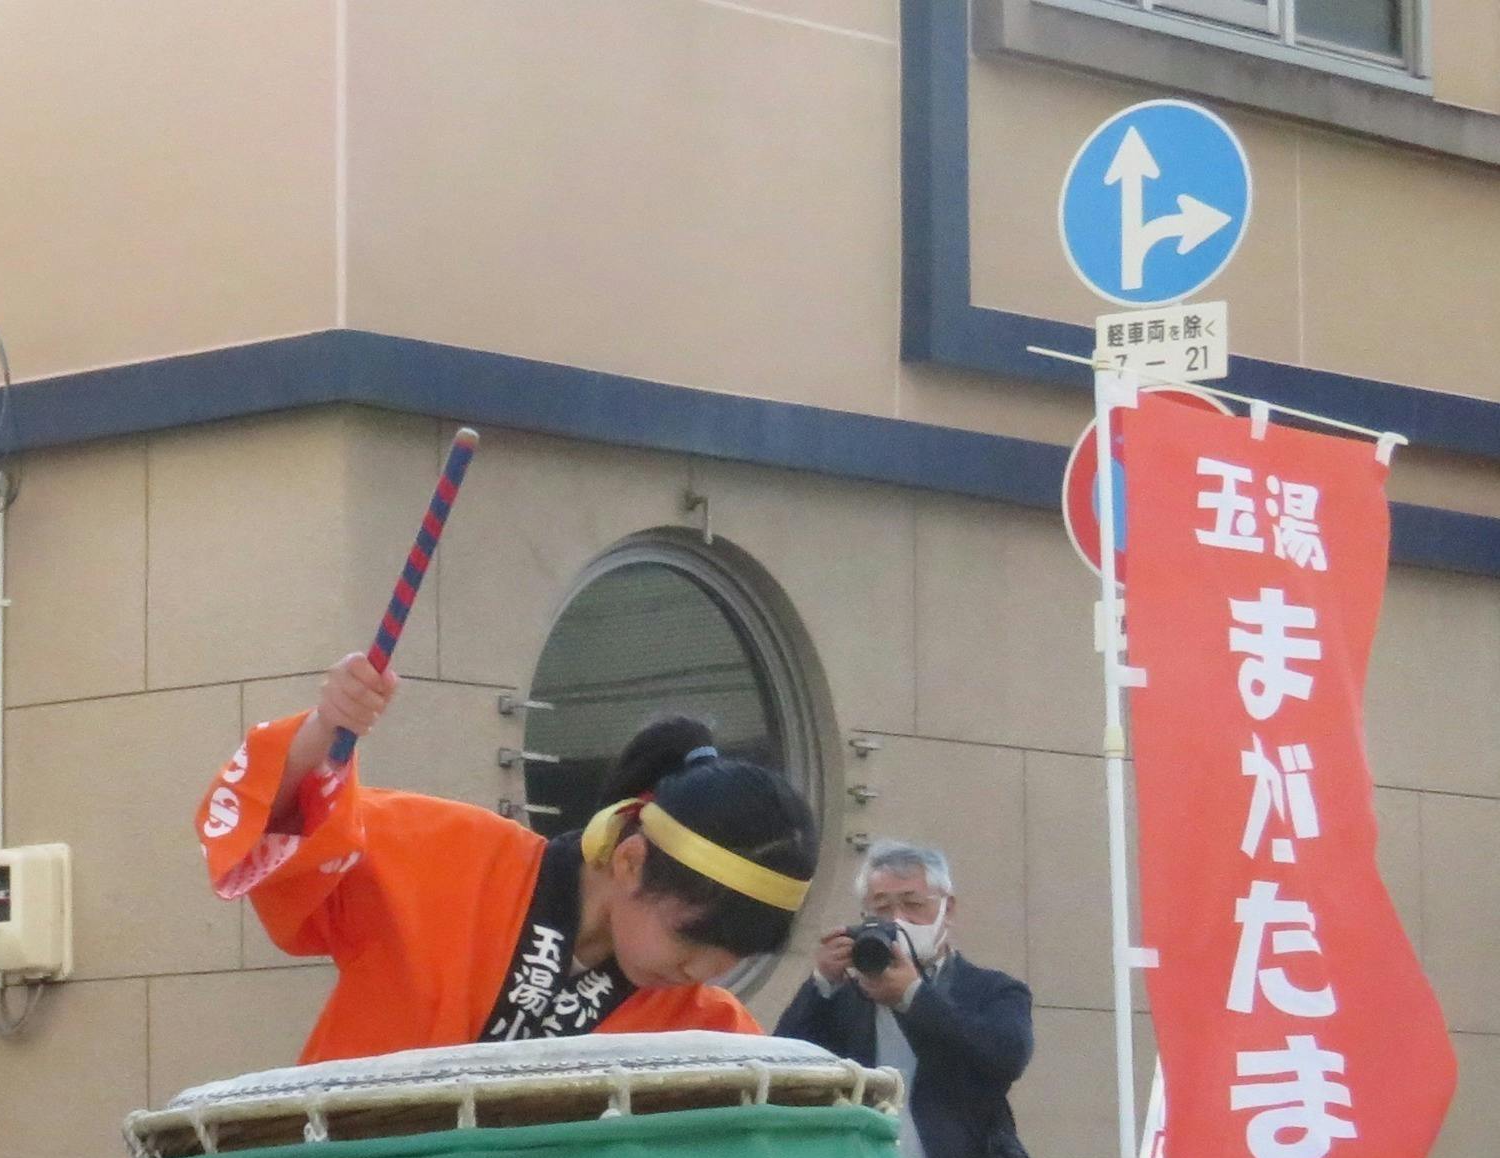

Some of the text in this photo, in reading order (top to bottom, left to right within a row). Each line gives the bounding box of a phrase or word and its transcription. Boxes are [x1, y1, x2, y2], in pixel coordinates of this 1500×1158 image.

[1107, 314, 1217, 347] 軽車両を除く
[1195, 456, 1328, 572] 玉湯
